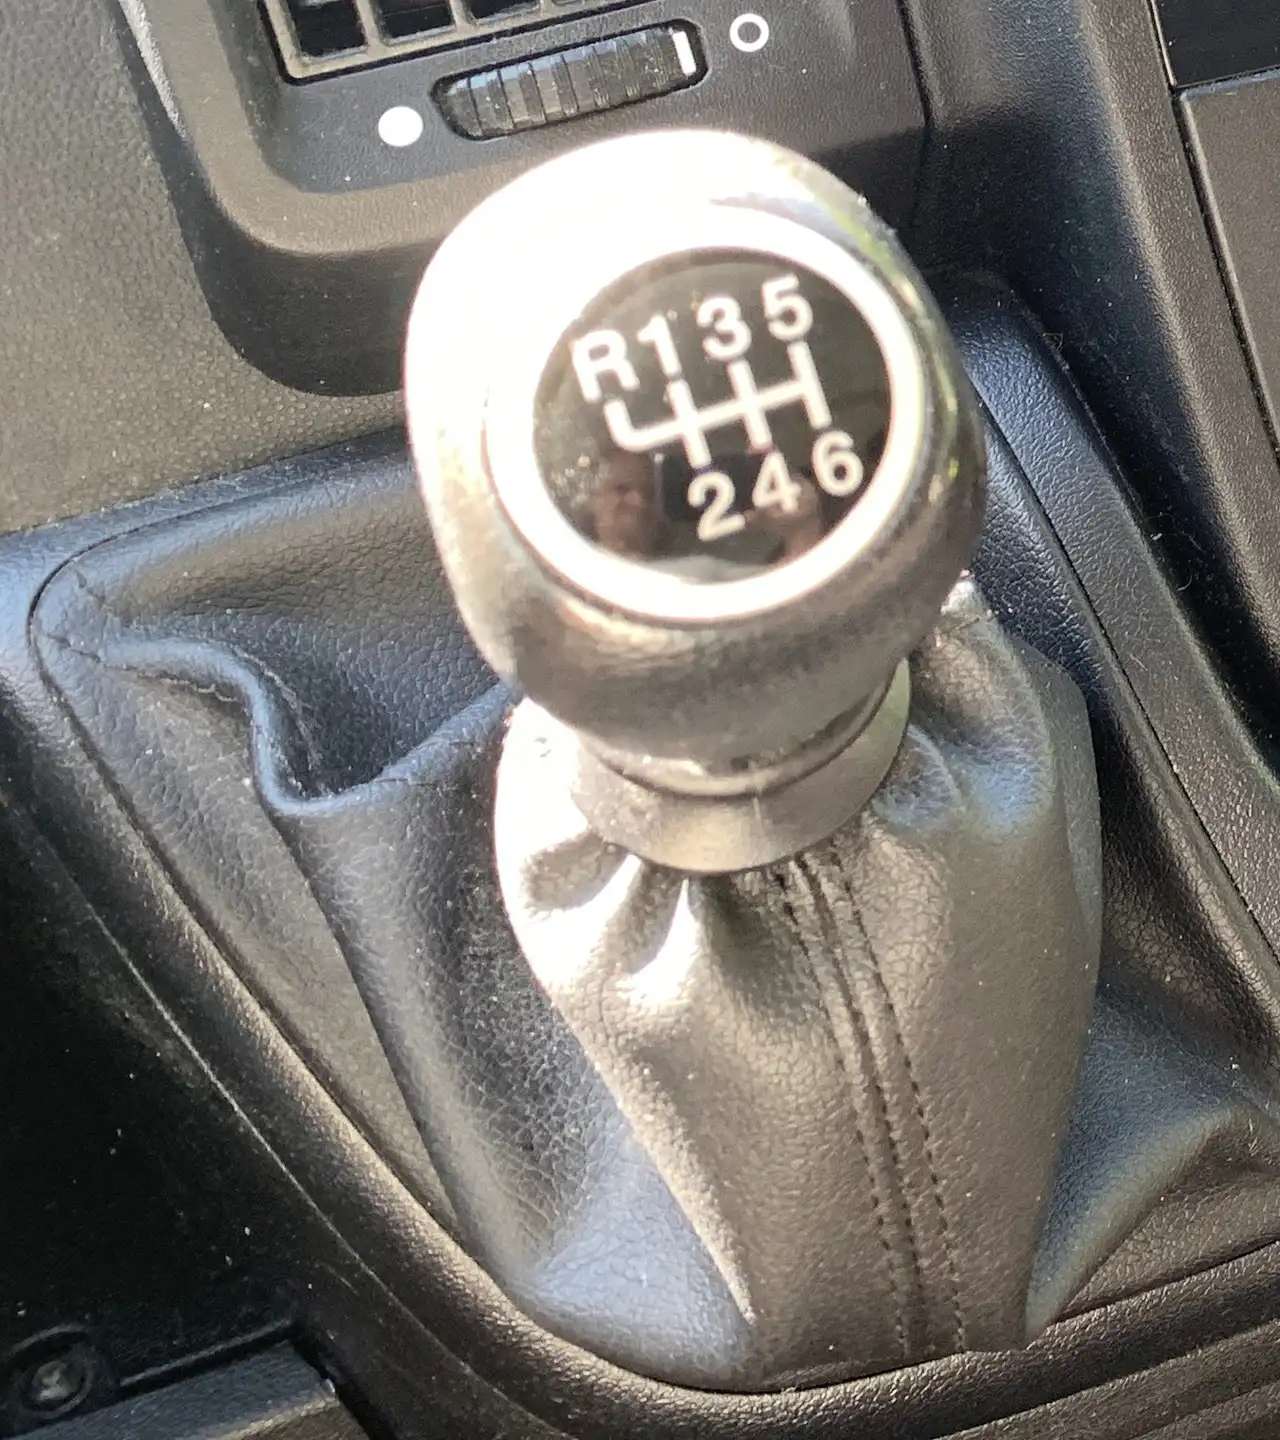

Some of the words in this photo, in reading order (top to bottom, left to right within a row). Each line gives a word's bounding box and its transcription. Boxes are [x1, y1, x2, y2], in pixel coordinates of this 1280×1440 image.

[570, 330, 640, 402] R
[636, 314, 683, 377] 1
[696, 296, 752, 360] 3
[760, 273, 814, 341] 5
[687, 472, 747, 542] 2
[751, 451, 802, 512] 4
[811, 430, 865, 497] 6
